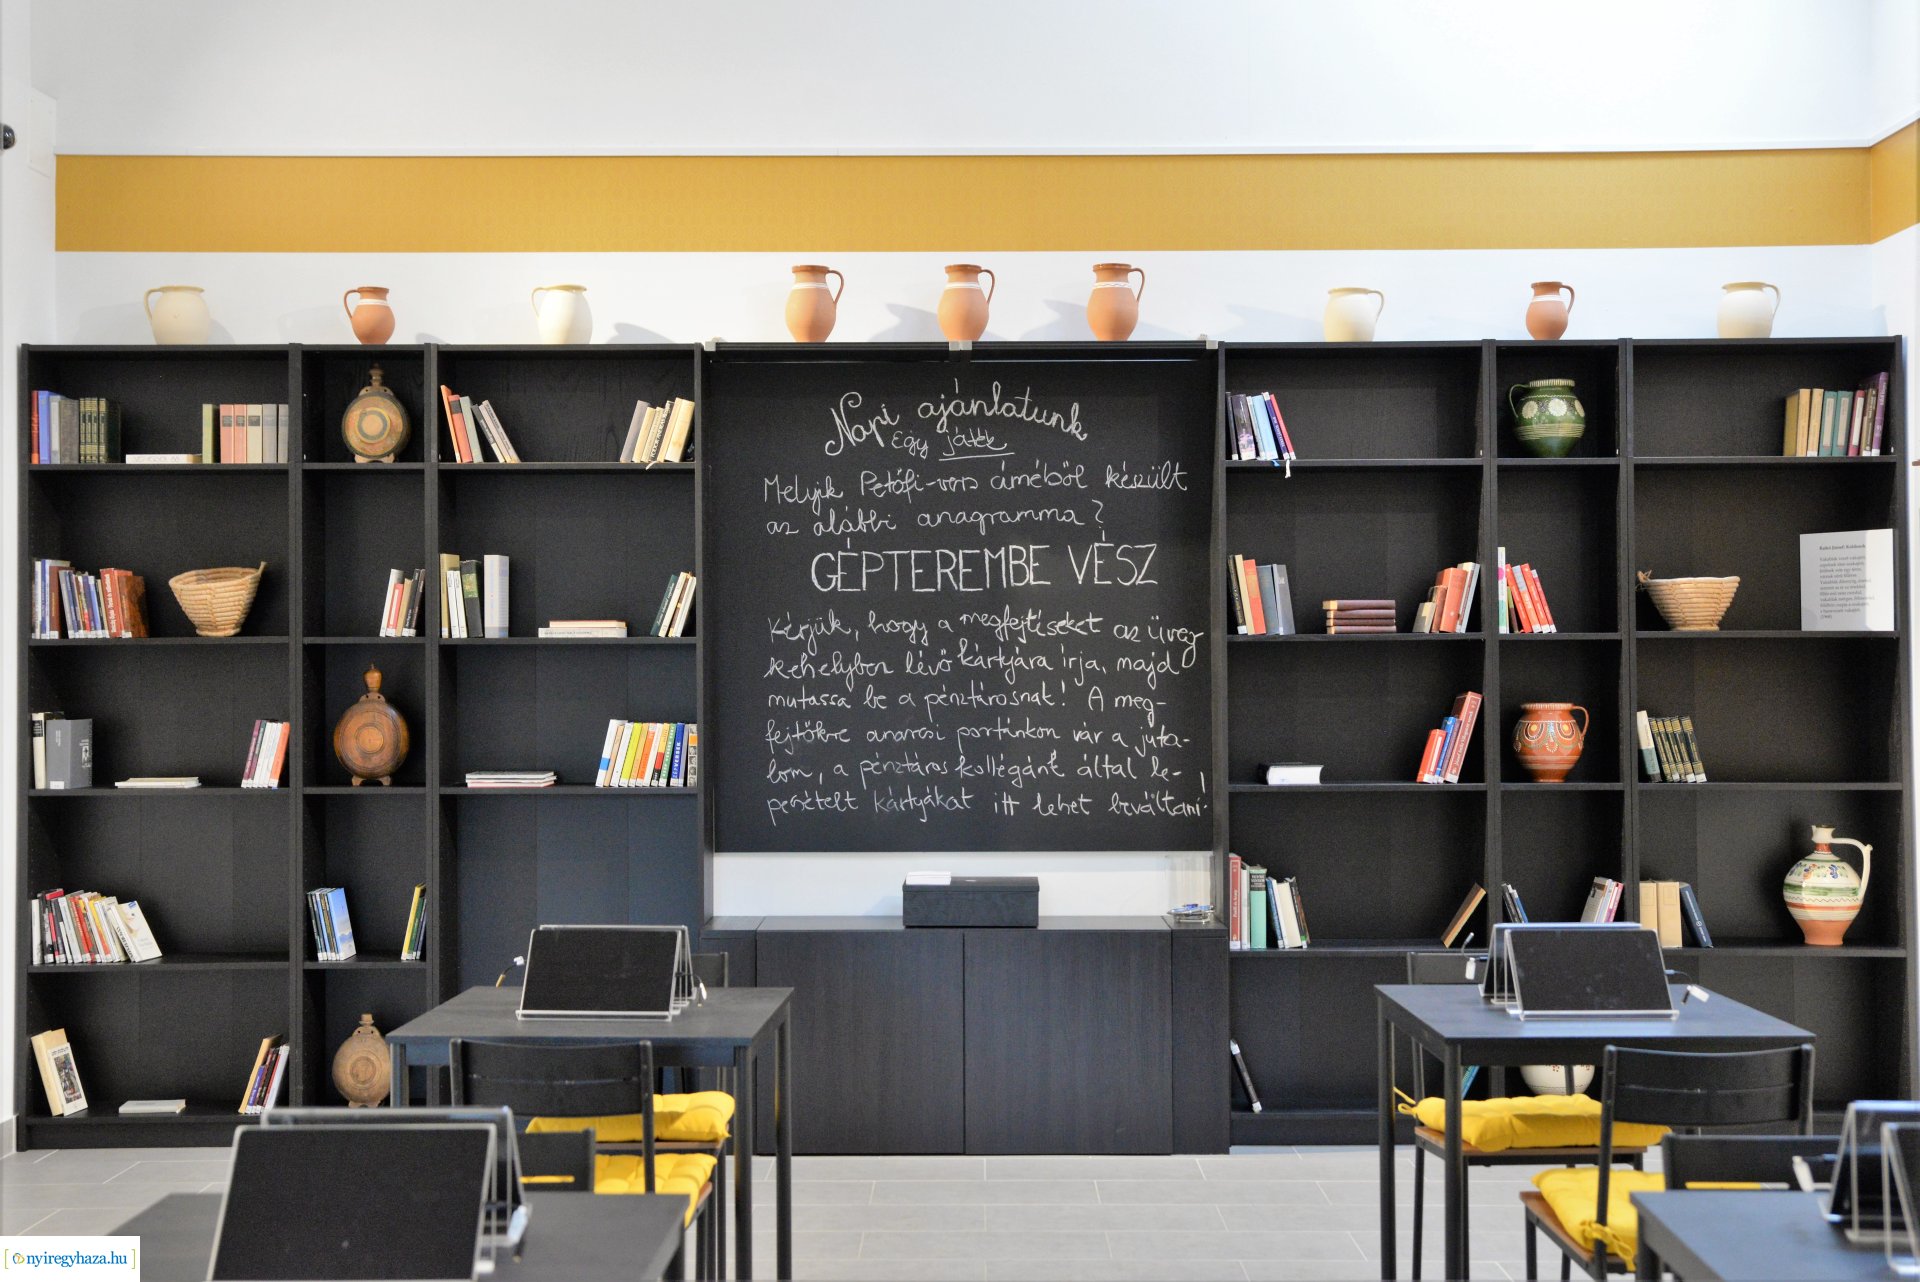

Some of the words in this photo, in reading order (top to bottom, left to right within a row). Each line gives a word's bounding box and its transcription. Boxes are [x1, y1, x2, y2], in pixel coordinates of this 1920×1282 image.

[825, 391, 900, 456] Napi
[917, 377, 1088, 441] ajánlatunk
[892, 430, 929, 459] Egy
[942, 426, 1007, 456] játék
[764, 475, 843, 515] Melyik
[1105, 460, 1188, 491] készült
[766, 519, 799, 535] az
[813, 506, 897, 535] alábbi
[810, 537, 1052, 593] GÉPTEREMBE
[1067, 529, 1158, 586] VÉSZ
[869, 610, 929, 647] hogy
[938, 619, 955, 633] a
[959, 604, 1103, 643] megfejtéseket
[1113, 624, 1141, 642] az
[906, 649, 953, 676] lévő
[958, 639, 1053, 684] kártyára
[1117, 651, 1180, 690] majd
[768, 684, 851, 710] mutassa
[863, 684, 888, 709] be
[898, 692, 916, 707] a
[1088, 686, 1104, 712] A
[957, 717, 1061, 753] portánkon
[1073, 722, 1103, 744] vár
[1111, 732, 1129, 748] a
[833, 764, 849, 776] a
[860, 752, 948, 790] pénztáros
[1077, 753, 1137, 780] által
[873, 785, 974, 823] kártyákat
[994, 792, 1020, 816] itt
[1032, 792, 1092, 816] lehet
